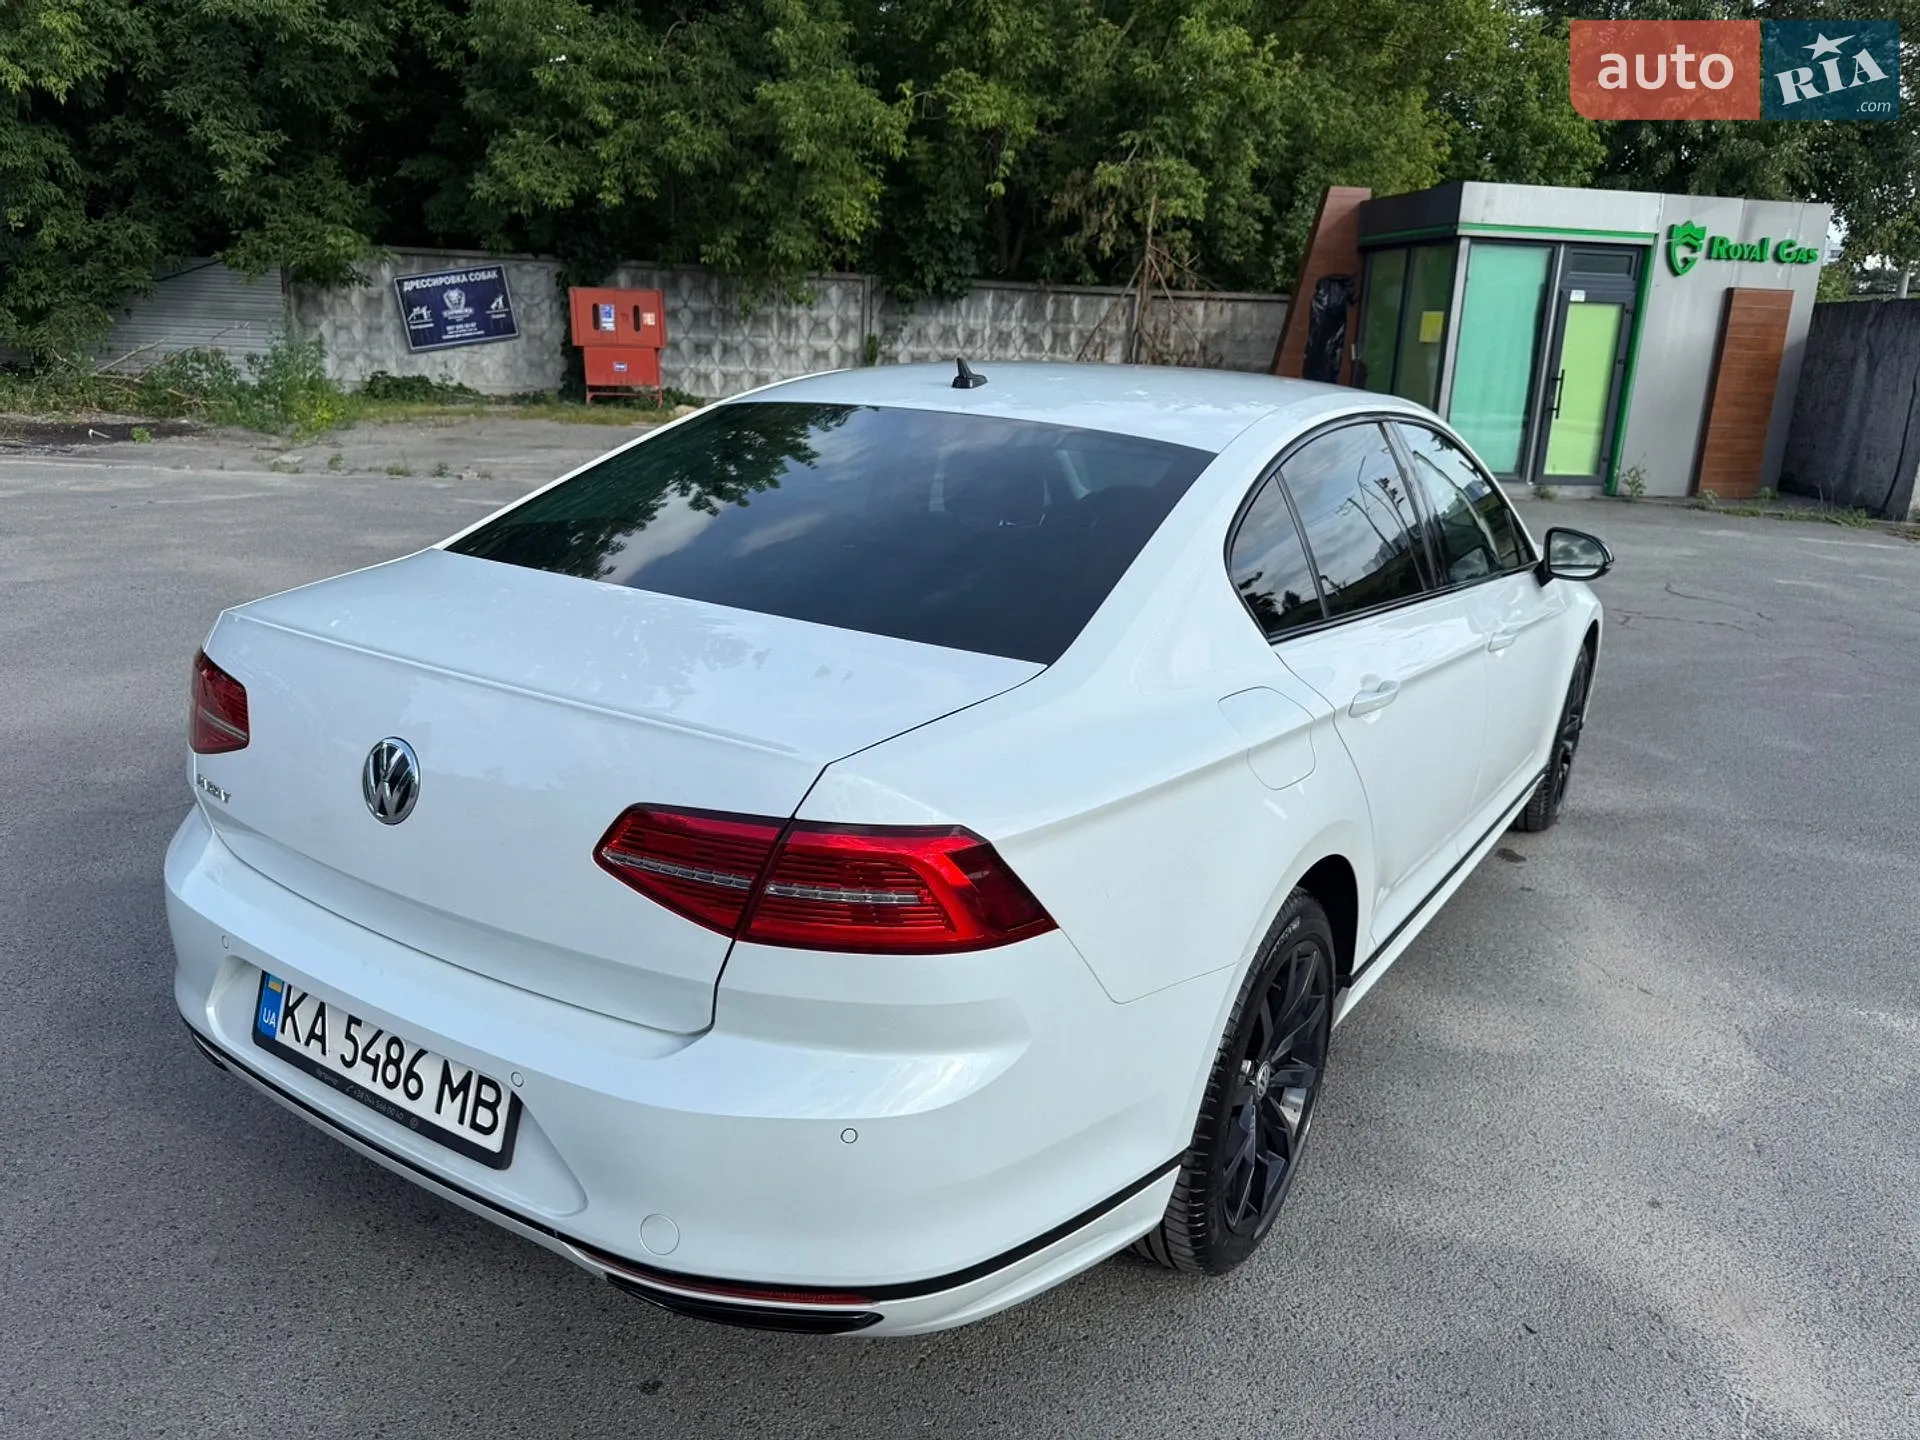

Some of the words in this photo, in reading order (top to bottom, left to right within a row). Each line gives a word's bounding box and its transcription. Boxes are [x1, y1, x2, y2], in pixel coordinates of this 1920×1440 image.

[403, 273, 469, 292] ДРЕССИРОВКА
[468, 270, 498, 282] СОБАК
[263, 1007, 276, 1029] UA
[280, 984, 327, 1056] KA
[340, 1014, 428, 1101] 5486
[435, 1060, 502, 1136] MB
